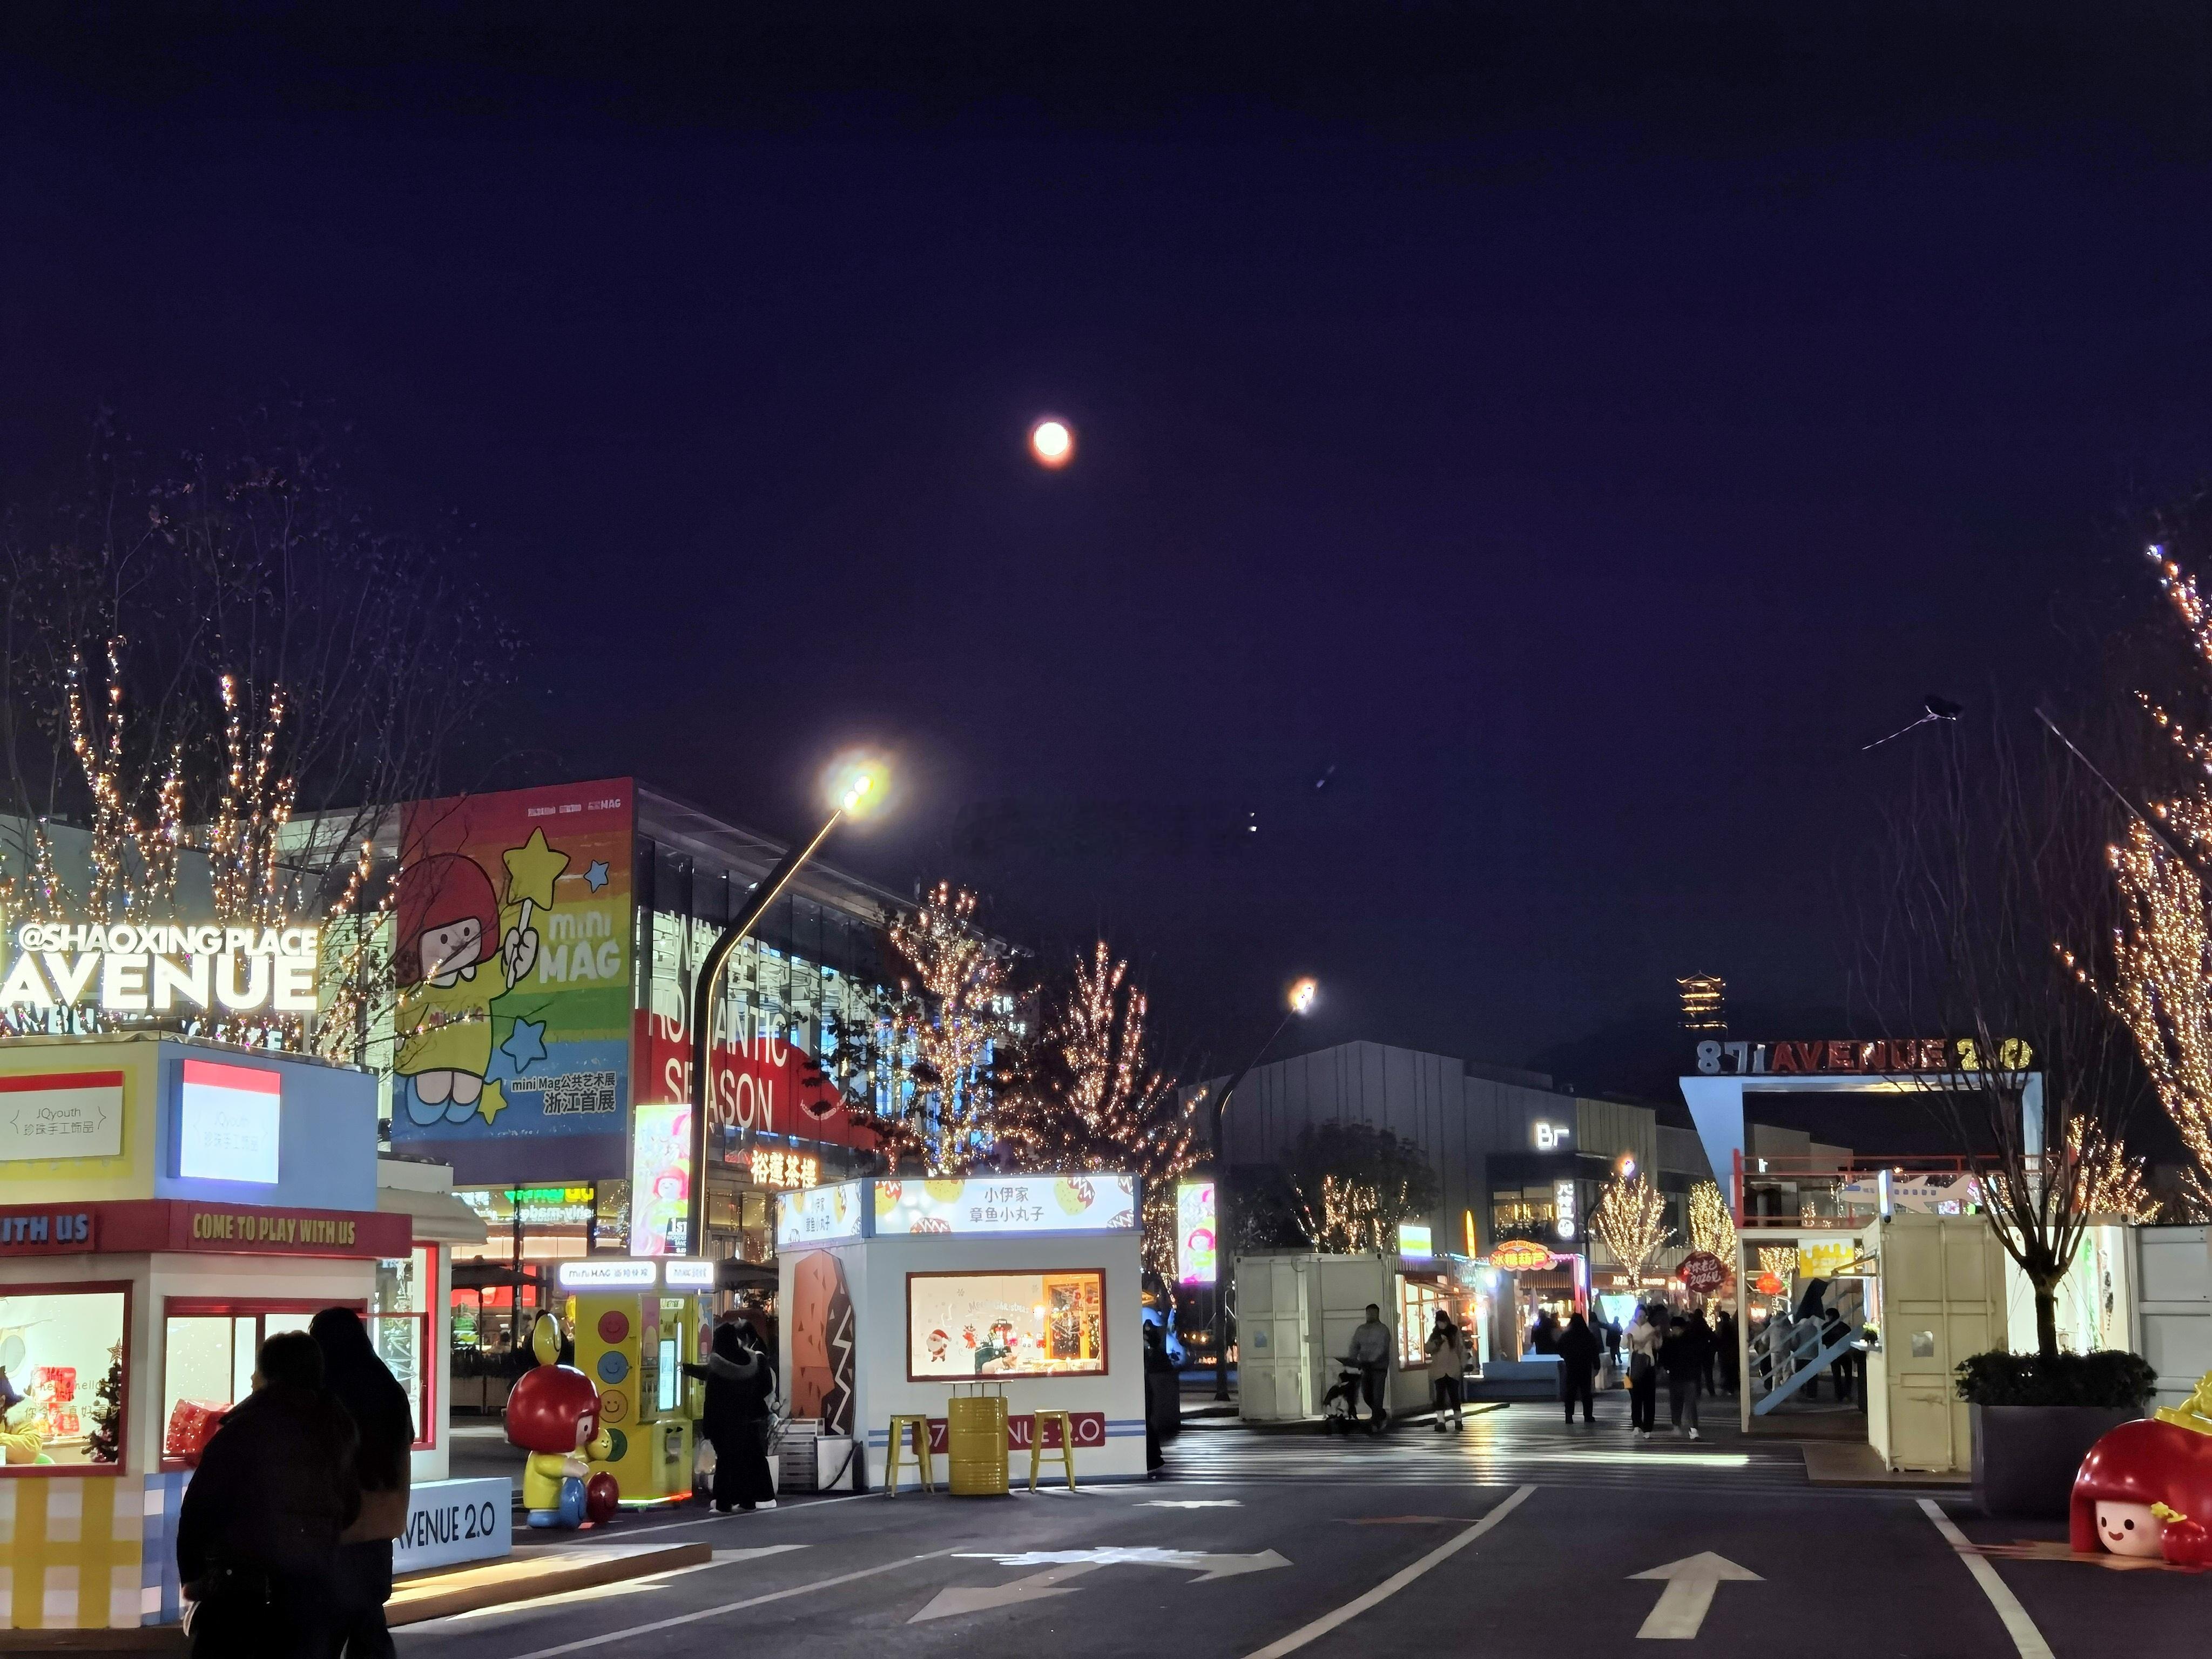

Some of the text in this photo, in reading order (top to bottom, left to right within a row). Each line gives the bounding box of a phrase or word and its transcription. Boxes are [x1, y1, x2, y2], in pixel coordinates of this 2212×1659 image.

[18, 923, 319, 956] @SHAOXING PLACE
[548, 911, 612, 941] mini
[539, 939, 621, 983] MAG
[670, 909, 771, 995] WINER
[0, 952, 319, 1010] AVENUE
[649, 978, 787, 1067] ROANTIC
[1696, 1037, 2033, 1074] 871 AVENUE 20
[511, 1072, 616, 1091] mini Mag公共艺术展
[36, 1107, 82, 1121] JQyouth
[544, 1089, 615, 1114] 浙江首展
[23, 1121, 94, 1136] 珍珠手工饰品
[985, 1186, 1029, 1203] 小伊家
[0, 1213, 89, 1242] ITH US
[193, 1212, 355, 1245] COME TO PLAY WITH US
[805, 1215, 830, 1232] 章鱼小丸子
[970, 1206, 1044, 1223] 章鱼小丸子
[1491, 1251, 1545, 1266] 冰糖葫芦
[464, 1501, 495, 1539] 2.0
